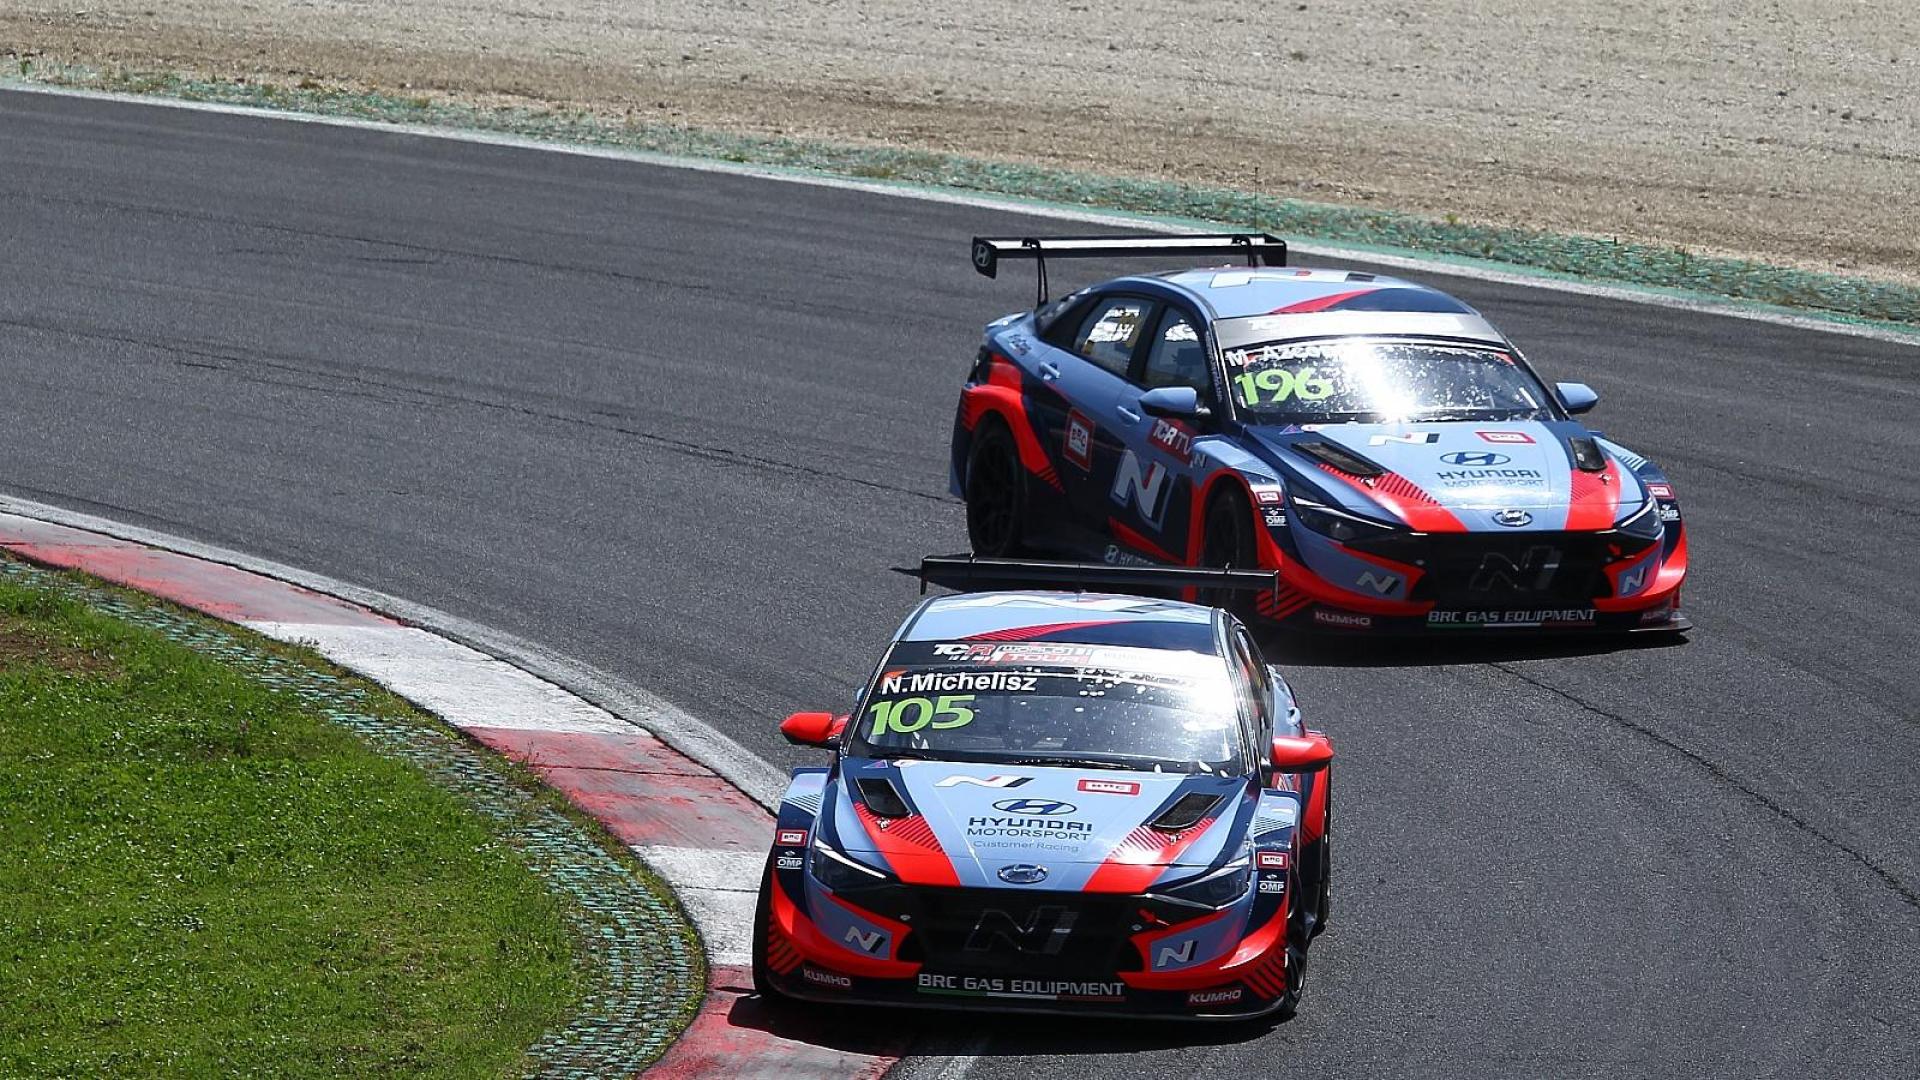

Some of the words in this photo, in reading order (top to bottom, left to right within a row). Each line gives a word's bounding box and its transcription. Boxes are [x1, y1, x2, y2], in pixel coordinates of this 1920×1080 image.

[1235, 367, 1333, 405] 196
[1153, 419, 1178, 446] TCR
[1436, 470, 1541, 479] HYUNDAI
[1314, 611, 1371, 627] KUMHO
[1428, 610, 1461, 623] BRC
[1465, 610, 1499, 623] GAS
[1504, 609, 1598, 622] EQUIPMENT
[932, 643, 996, 656] TCR
[869, 694, 976, 736] 105
[968, 817, 1093, 832] HYUNDAI
[967, 828, 1092, 841] MOTORSPORT
[973, 840, 1033, 849] Customer
[1036, 843, 1079, 852] Racing
[777, 858, 802, 866] OMP
[1260, 882, 1285, 891] OMP
[803, 968, 851, 987] KUMHO
[918, 973, 958, 989] BRC
[963, 977, 1004, 991] GAS
[1011, 980, 1125, 996] EQUIPMENT
[1189, 988, 1243, 1003] KUMHO
